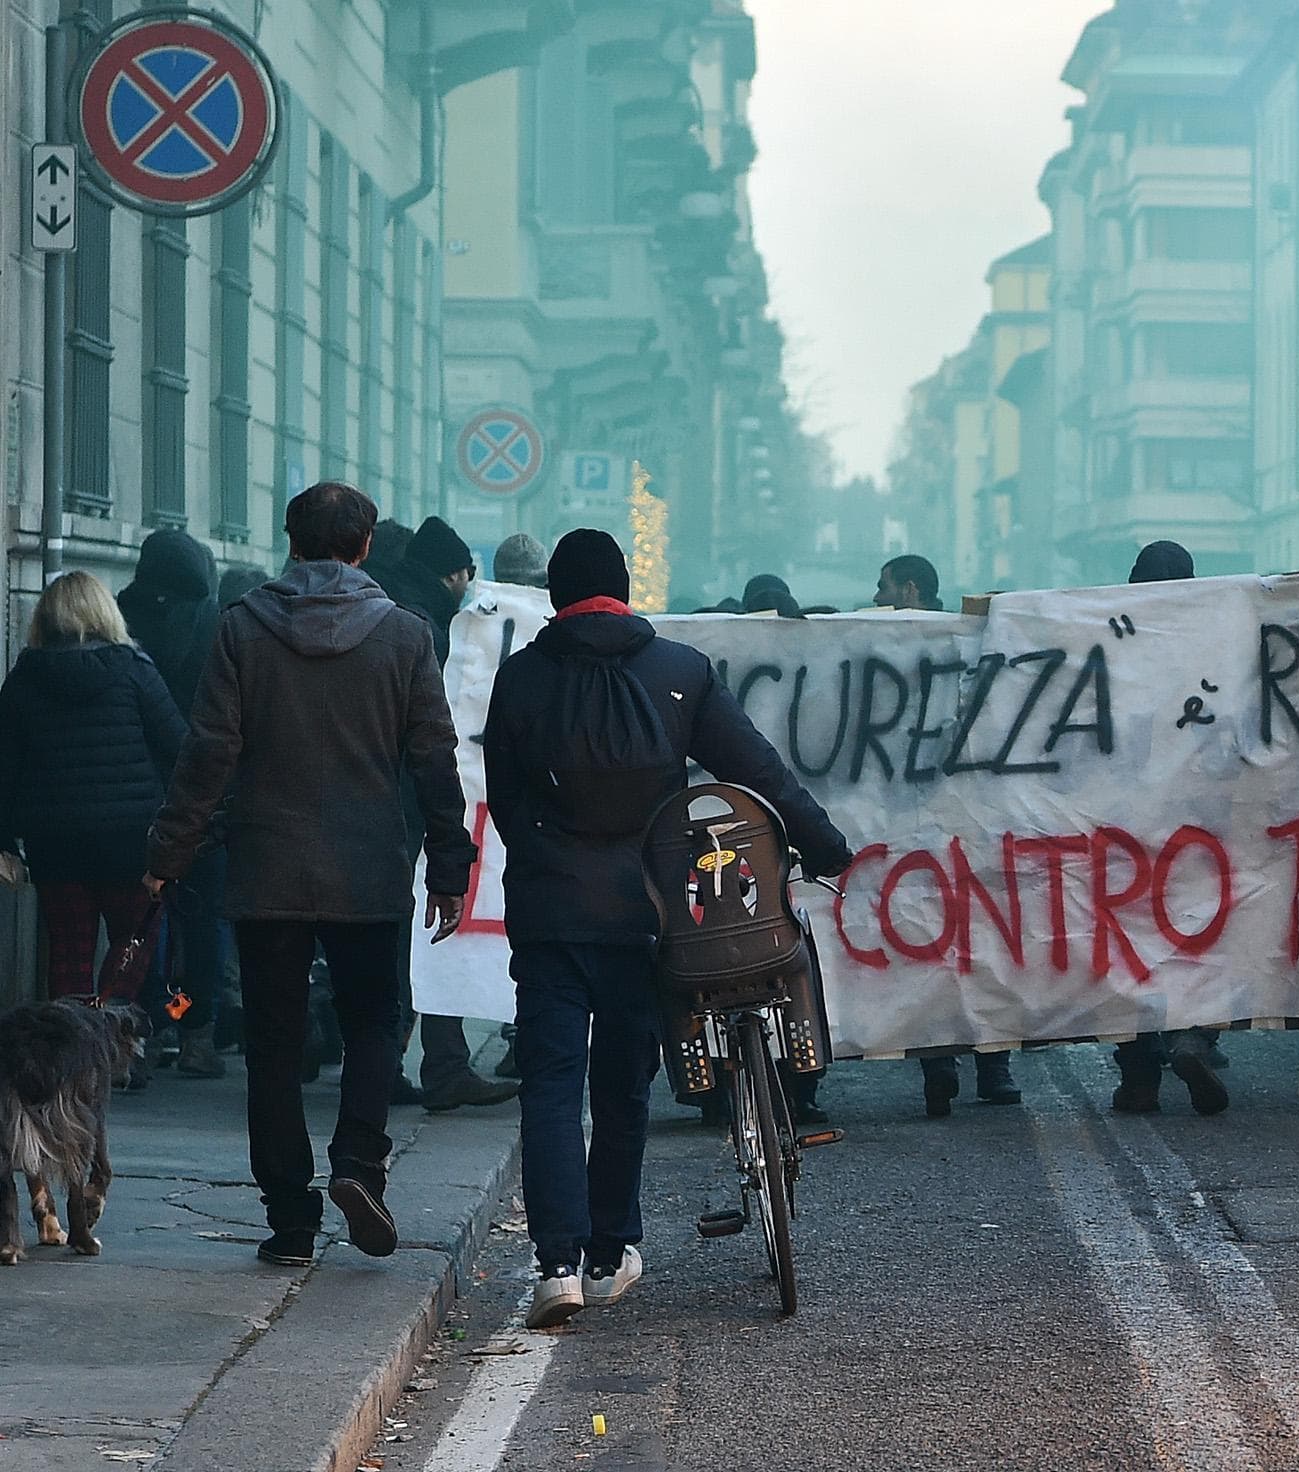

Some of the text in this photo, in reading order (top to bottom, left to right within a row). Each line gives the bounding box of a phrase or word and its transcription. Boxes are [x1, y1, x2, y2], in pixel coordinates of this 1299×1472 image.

[582, 459, 602, 485] P
[1176, 679, 1219, 729] è
[834, 824, 1232, 985] CONTRO
